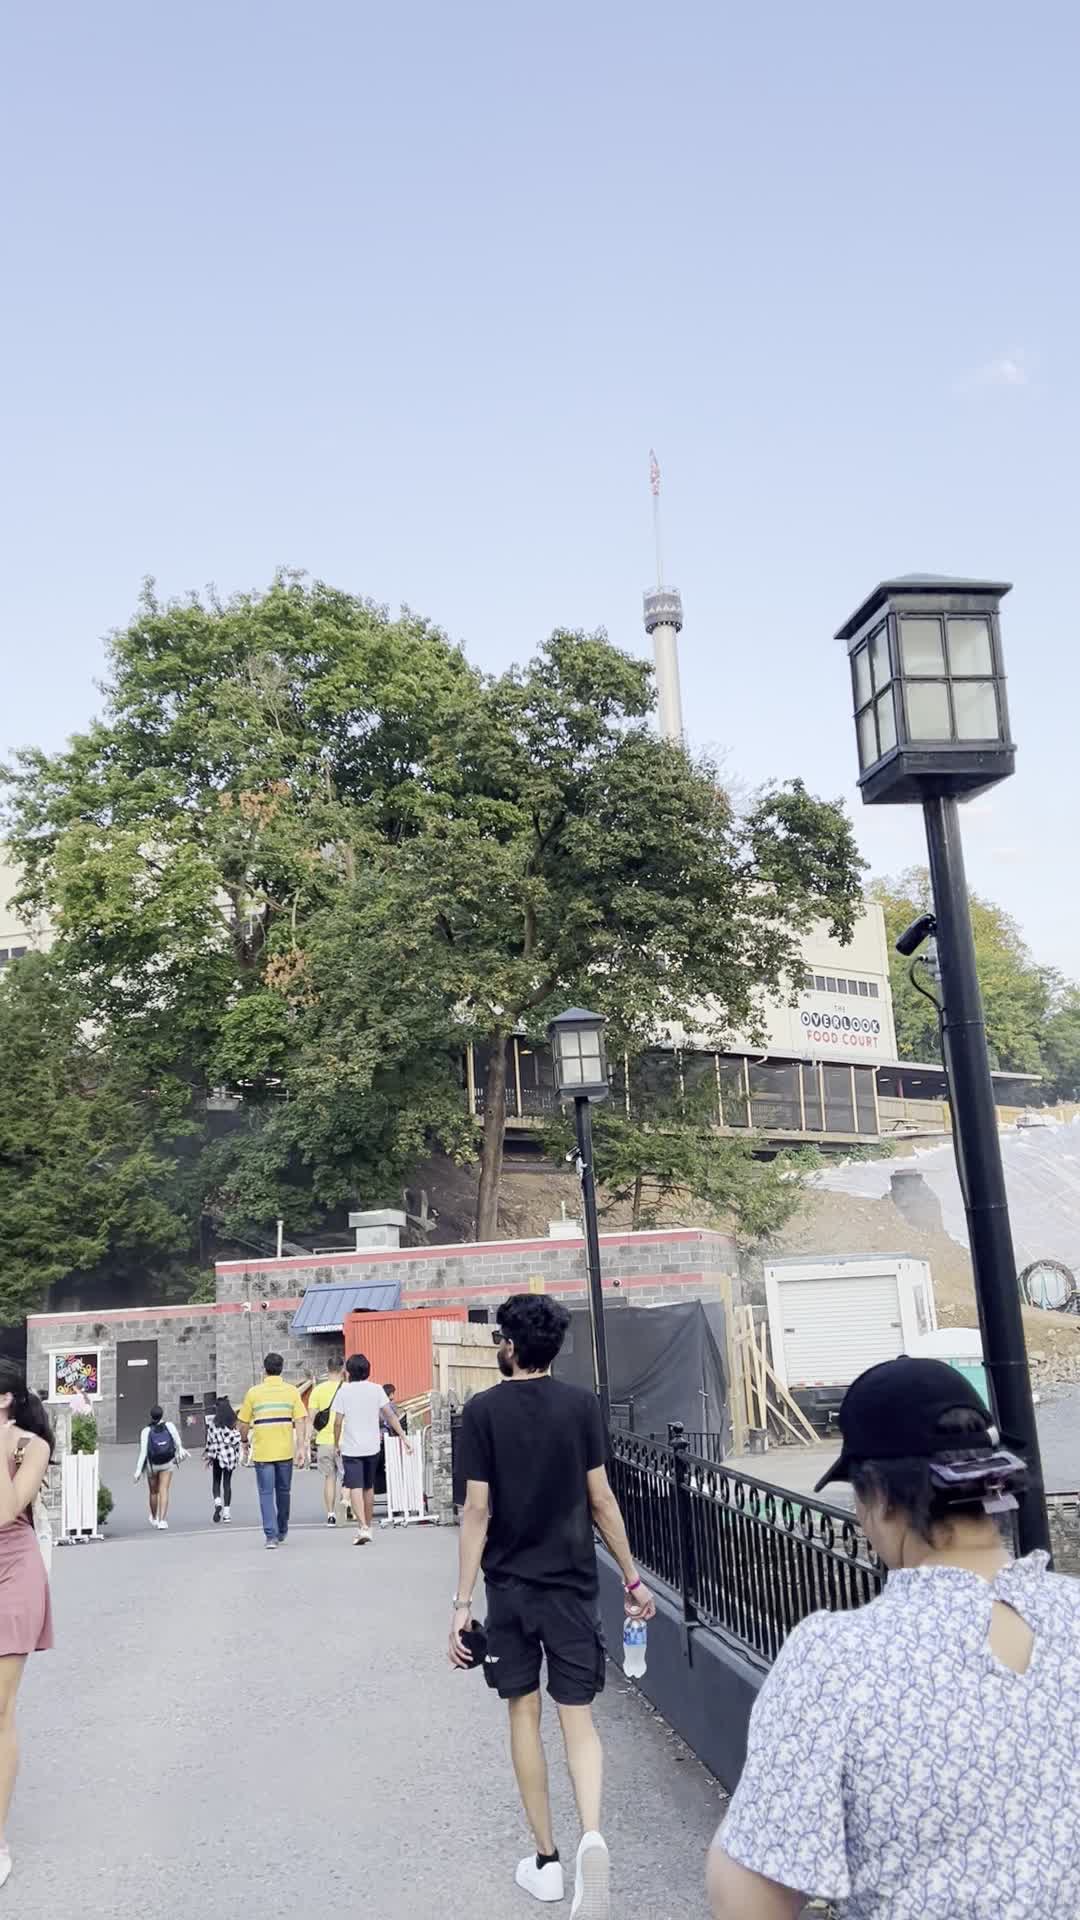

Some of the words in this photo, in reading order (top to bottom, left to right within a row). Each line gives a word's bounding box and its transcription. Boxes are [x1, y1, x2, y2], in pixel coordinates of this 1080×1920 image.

[801, 1011, 880, 1033] OVERLOOK
[807, 1030, 839, 1044] FOOD
[841, 1033, 879, 1048] COURT
